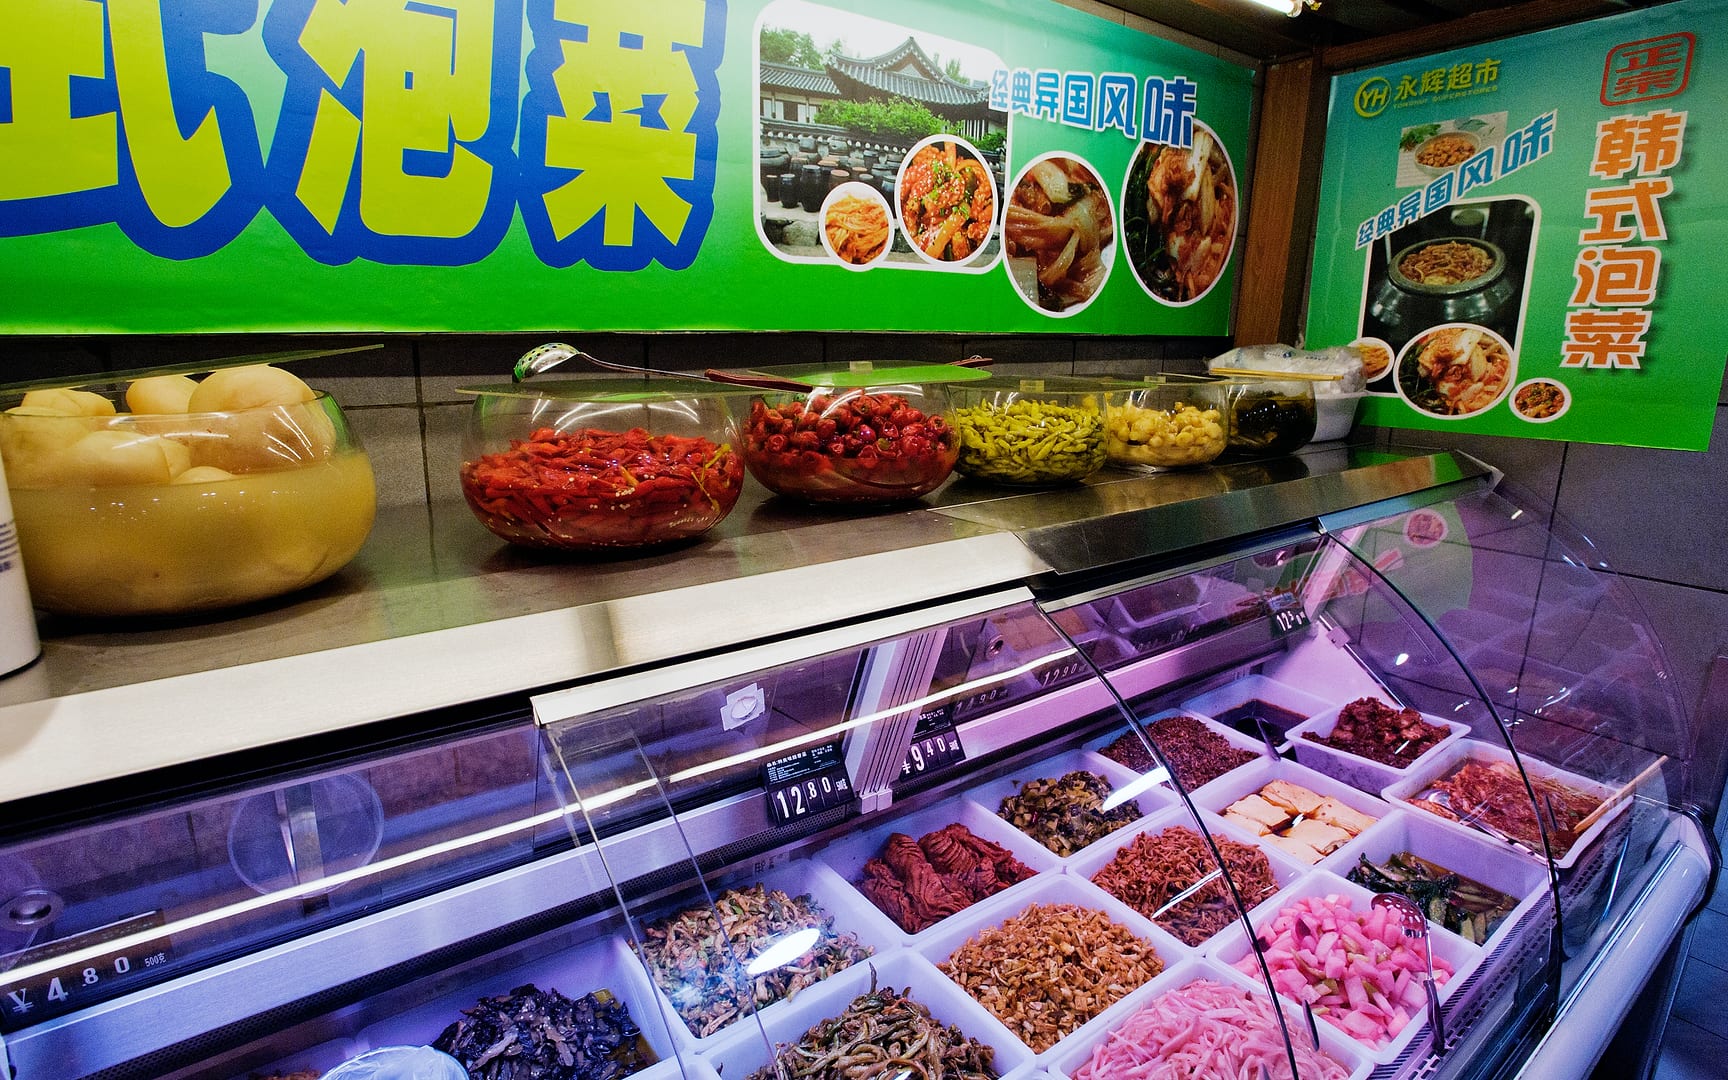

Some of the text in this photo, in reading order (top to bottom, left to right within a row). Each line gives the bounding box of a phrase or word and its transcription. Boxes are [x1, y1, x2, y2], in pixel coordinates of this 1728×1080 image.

[991, 68, 1197, 148] 经典异国风味
[1393, 58, 1502, 101] 永辉超市
[1357, 112, 1555, 247] 经典异国风味
[1563, 111, 1686, 367] 韩式泡菜
[777, 777, 832, 819] 12.80
[144, 952, 167, 967] 500克
